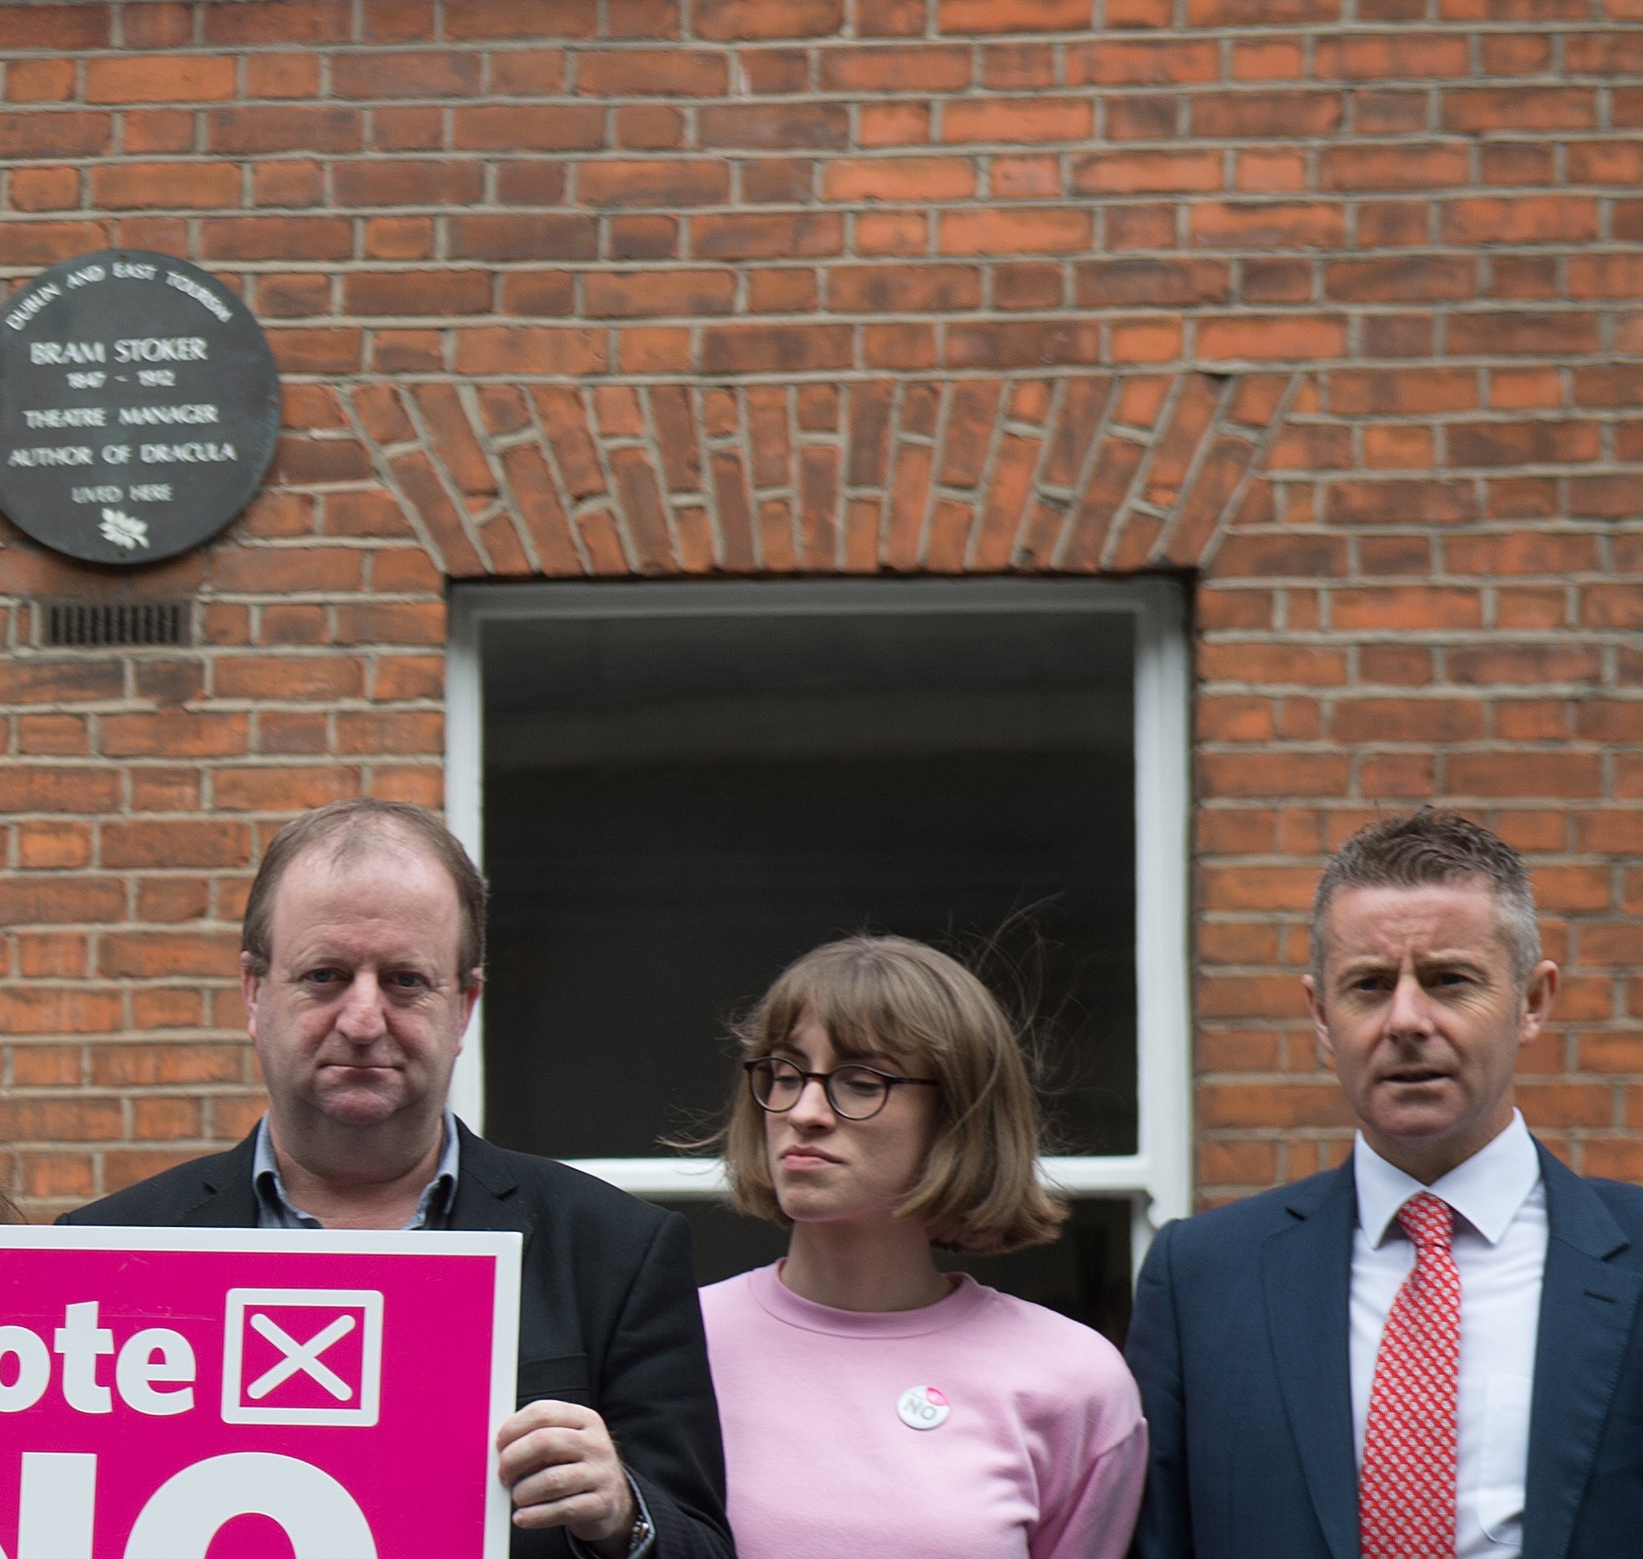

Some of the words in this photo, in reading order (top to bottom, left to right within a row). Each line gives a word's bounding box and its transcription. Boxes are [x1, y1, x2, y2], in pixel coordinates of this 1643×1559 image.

[5, 283, 62, 331] DUBLIN
[66, 265, 106, 290] AND
[112, 262, 158, 280] EAST
[166, 270, 233, 322] TOURISM
[29, 341, 107, 365] BRAM
[113, 337, 208, 363] STOKER
[23, 408, 107, 429] THEATRE
[118, 404, 219, 425] MANAGER
[8, 446, 94, 467] AUTHOR
[102, 444, 132, 465] OF
[140, 442, 238, 463] DRACULA
[71, 485, 124, 504] LIVED
[129, 483, 173, 502] HERE
[903, 1398, 937, 1420] NO
